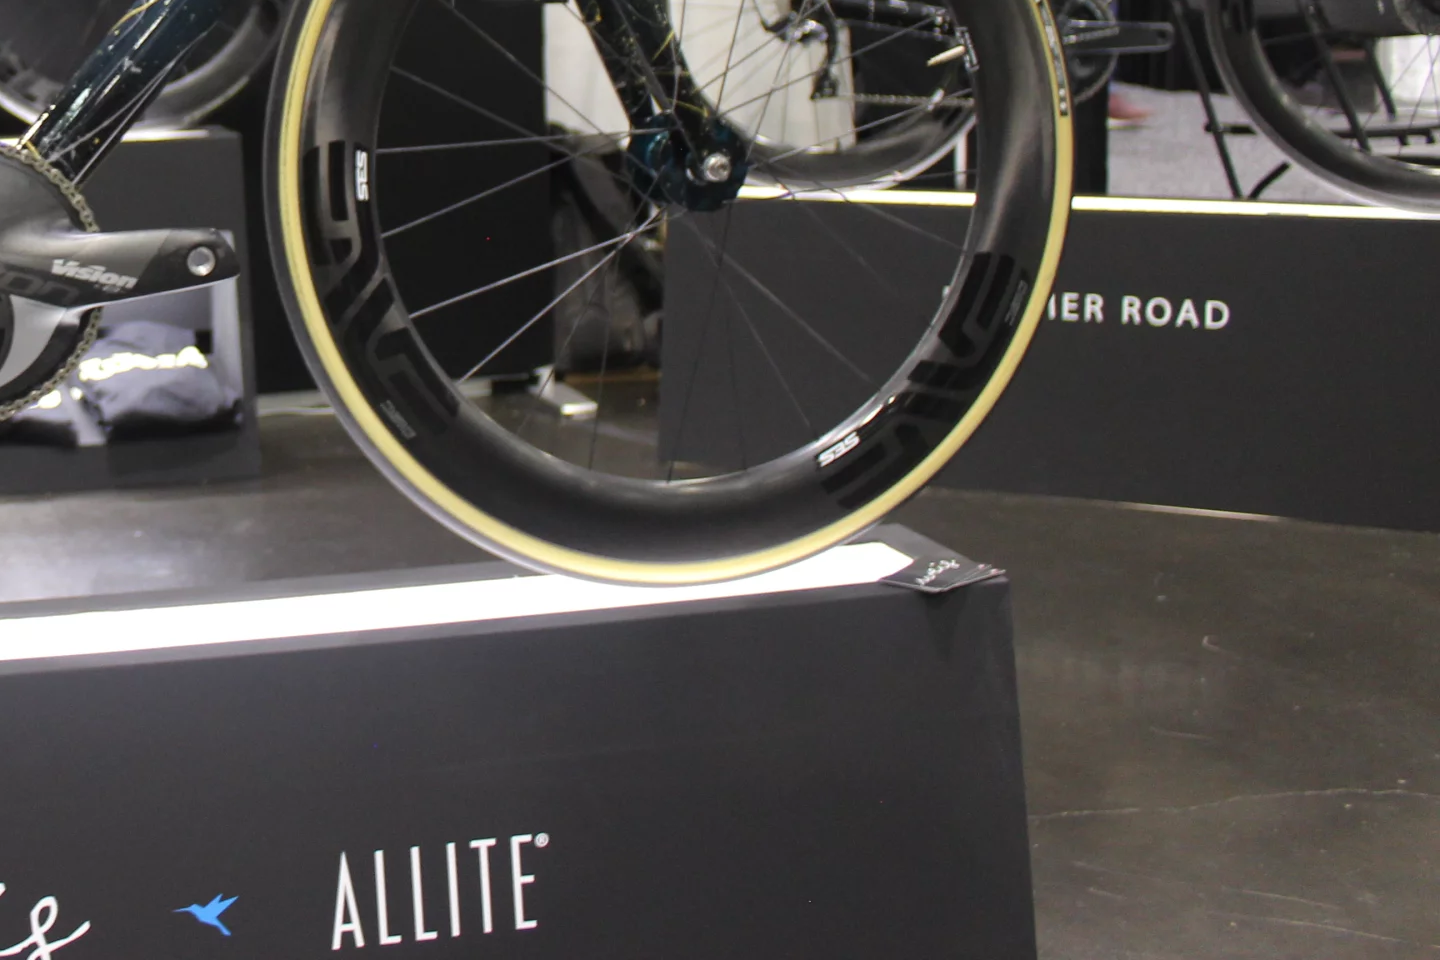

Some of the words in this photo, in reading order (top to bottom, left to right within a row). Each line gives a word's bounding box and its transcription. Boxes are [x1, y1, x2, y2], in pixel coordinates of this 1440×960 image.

[354, 149, 369, 201] SES
[51, 258, 139, 289] Vision
[1120, 295, 1231, 330] ROAD
[817, 431, 861, 468] SES
